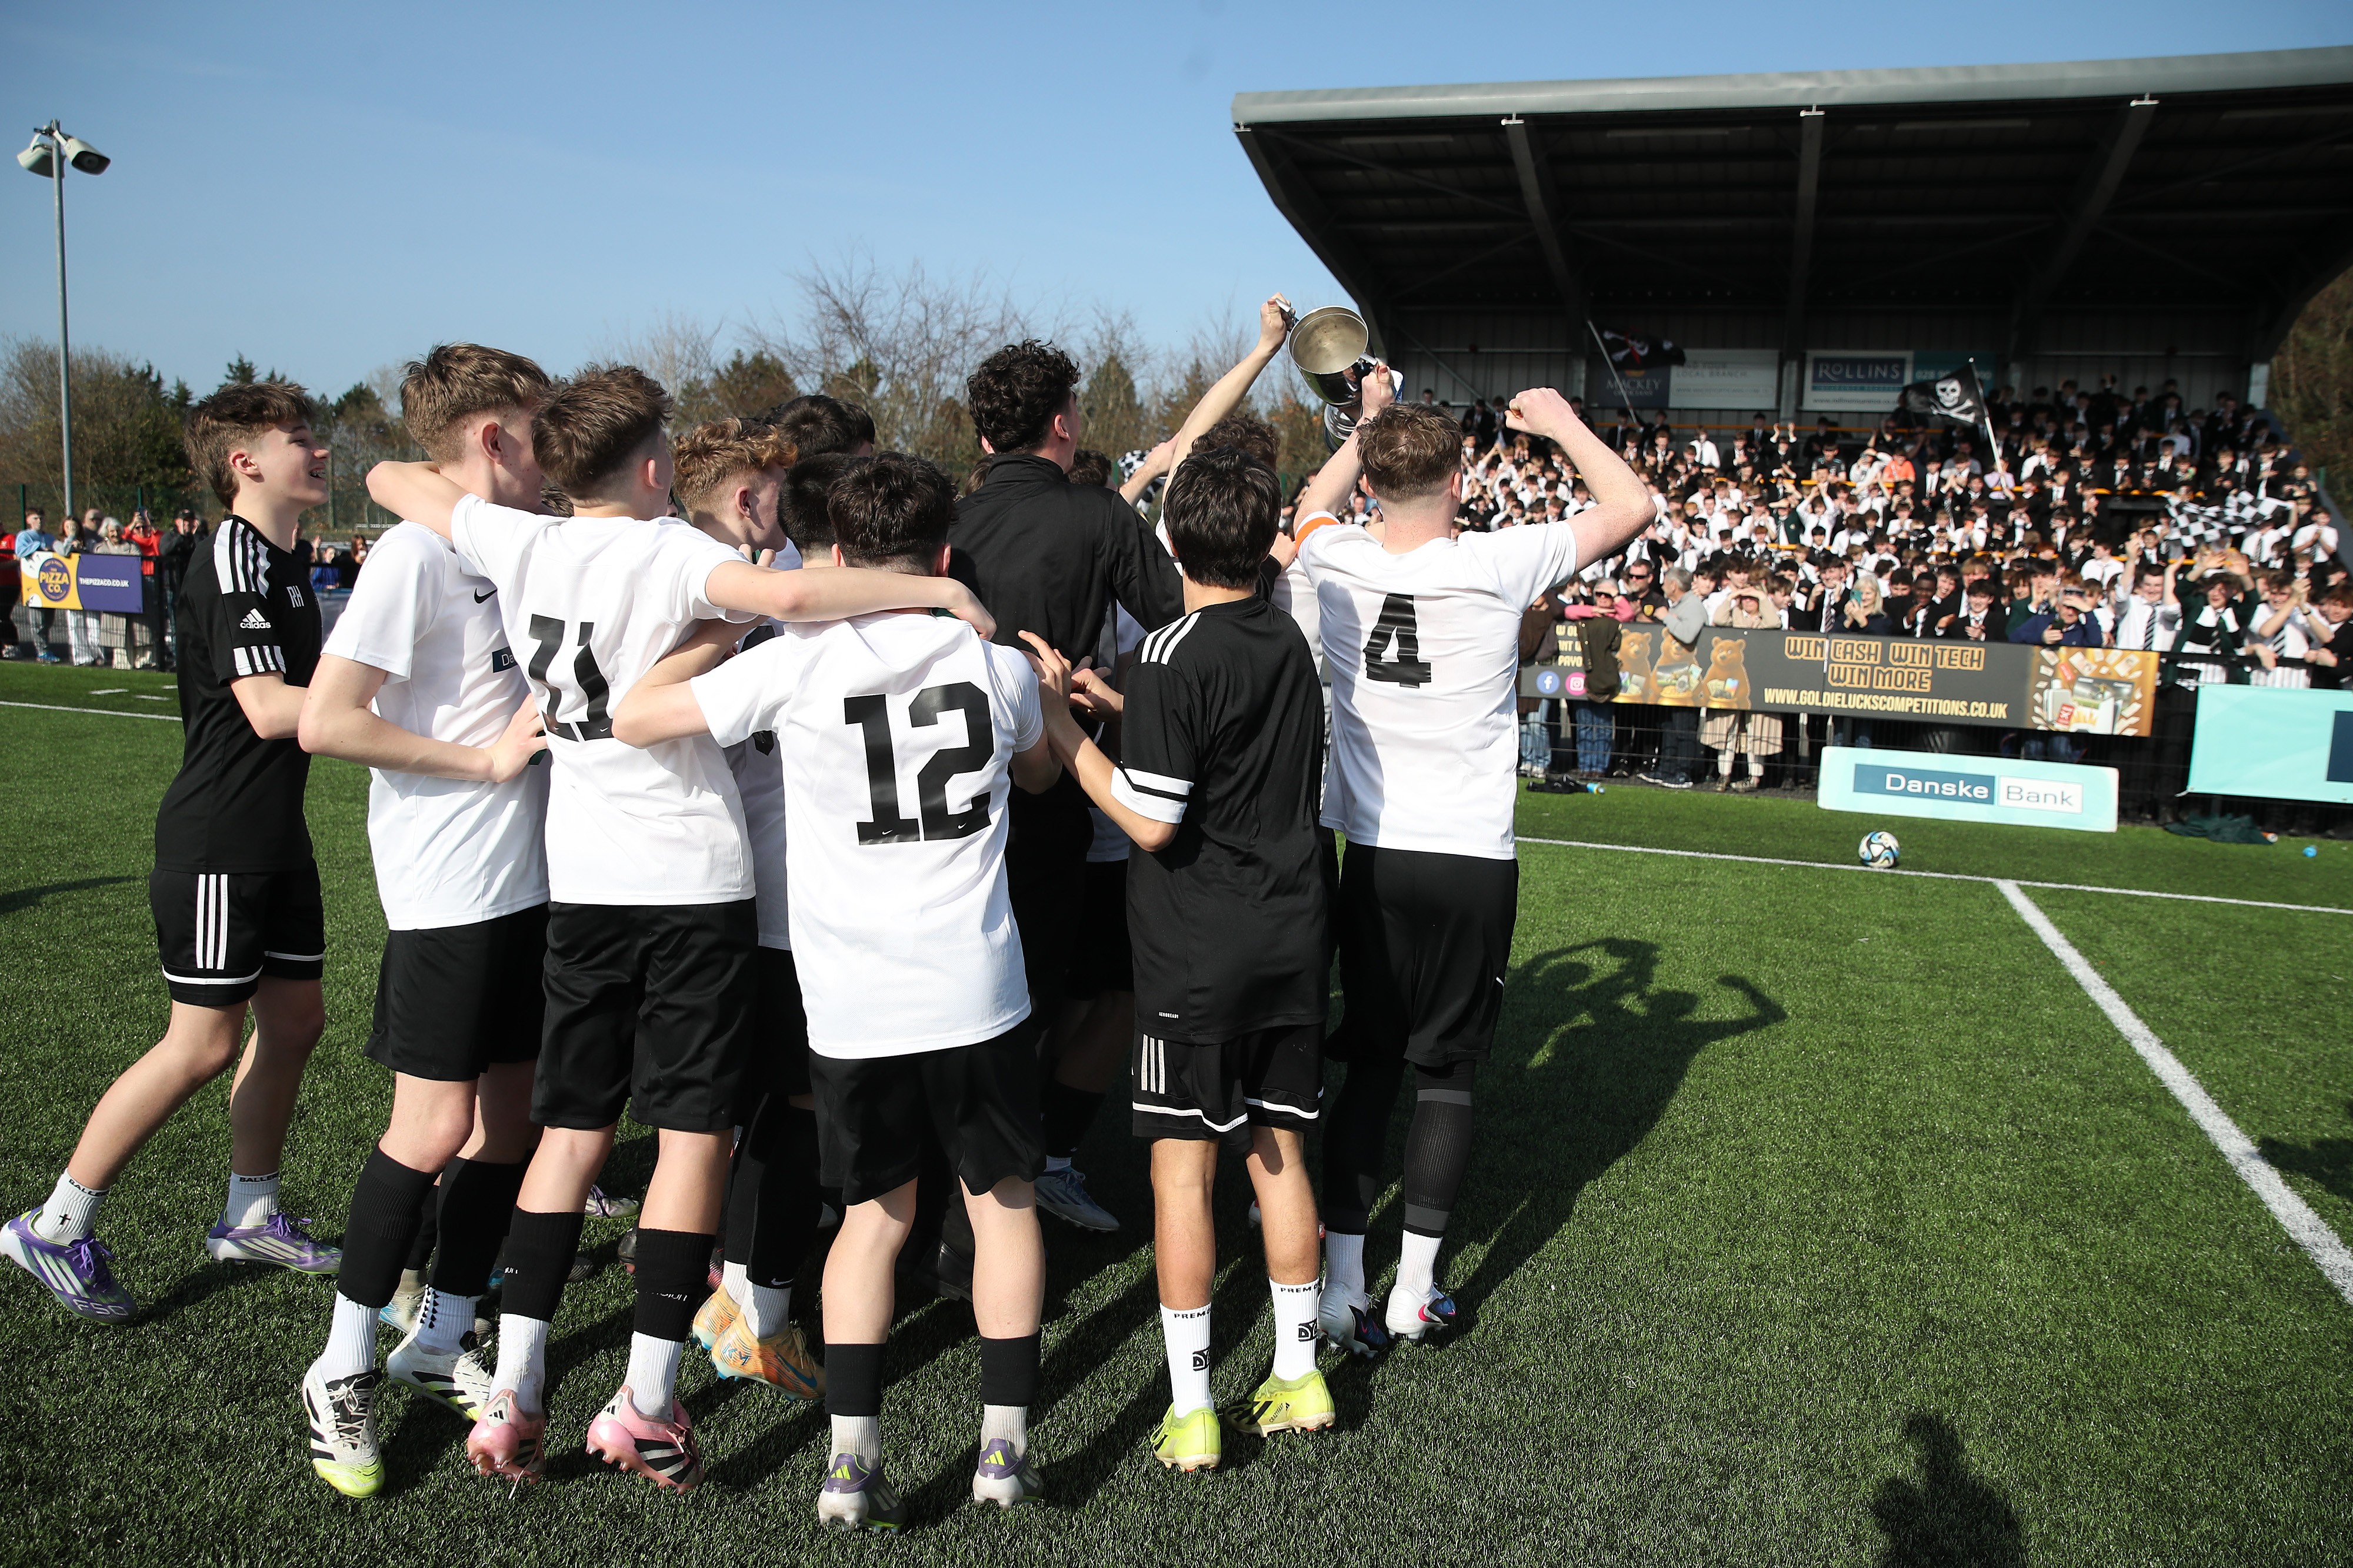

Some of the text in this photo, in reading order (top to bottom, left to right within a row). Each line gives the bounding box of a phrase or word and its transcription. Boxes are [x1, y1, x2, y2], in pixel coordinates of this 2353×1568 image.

[1818, 362, 1901, 382] ROLLINS
[39, 571, 69, 585] PIZZA
[48, 583, 63, 593] CO.
[79, 576, 129, 588] THEPIZZACO.CO.UK
[286, 585, 305, 608] RH
[239, 621, 271, 629] adidas
[1363, 593, 1431, 689] 4
[1785, 636, 1986, 671] WIN CASH WIN TECH
[1827, 663, 1932, 692] WIN MORE
[1764, 688, 2008, 719] WWW.GOLDIELUCKSCOMPETITIONS.CO.UK
[844, 681, 994, 845] 12
[1885, 773, 2074, 807] Danske Bank
[73, 1298, 129, 1316] F50
